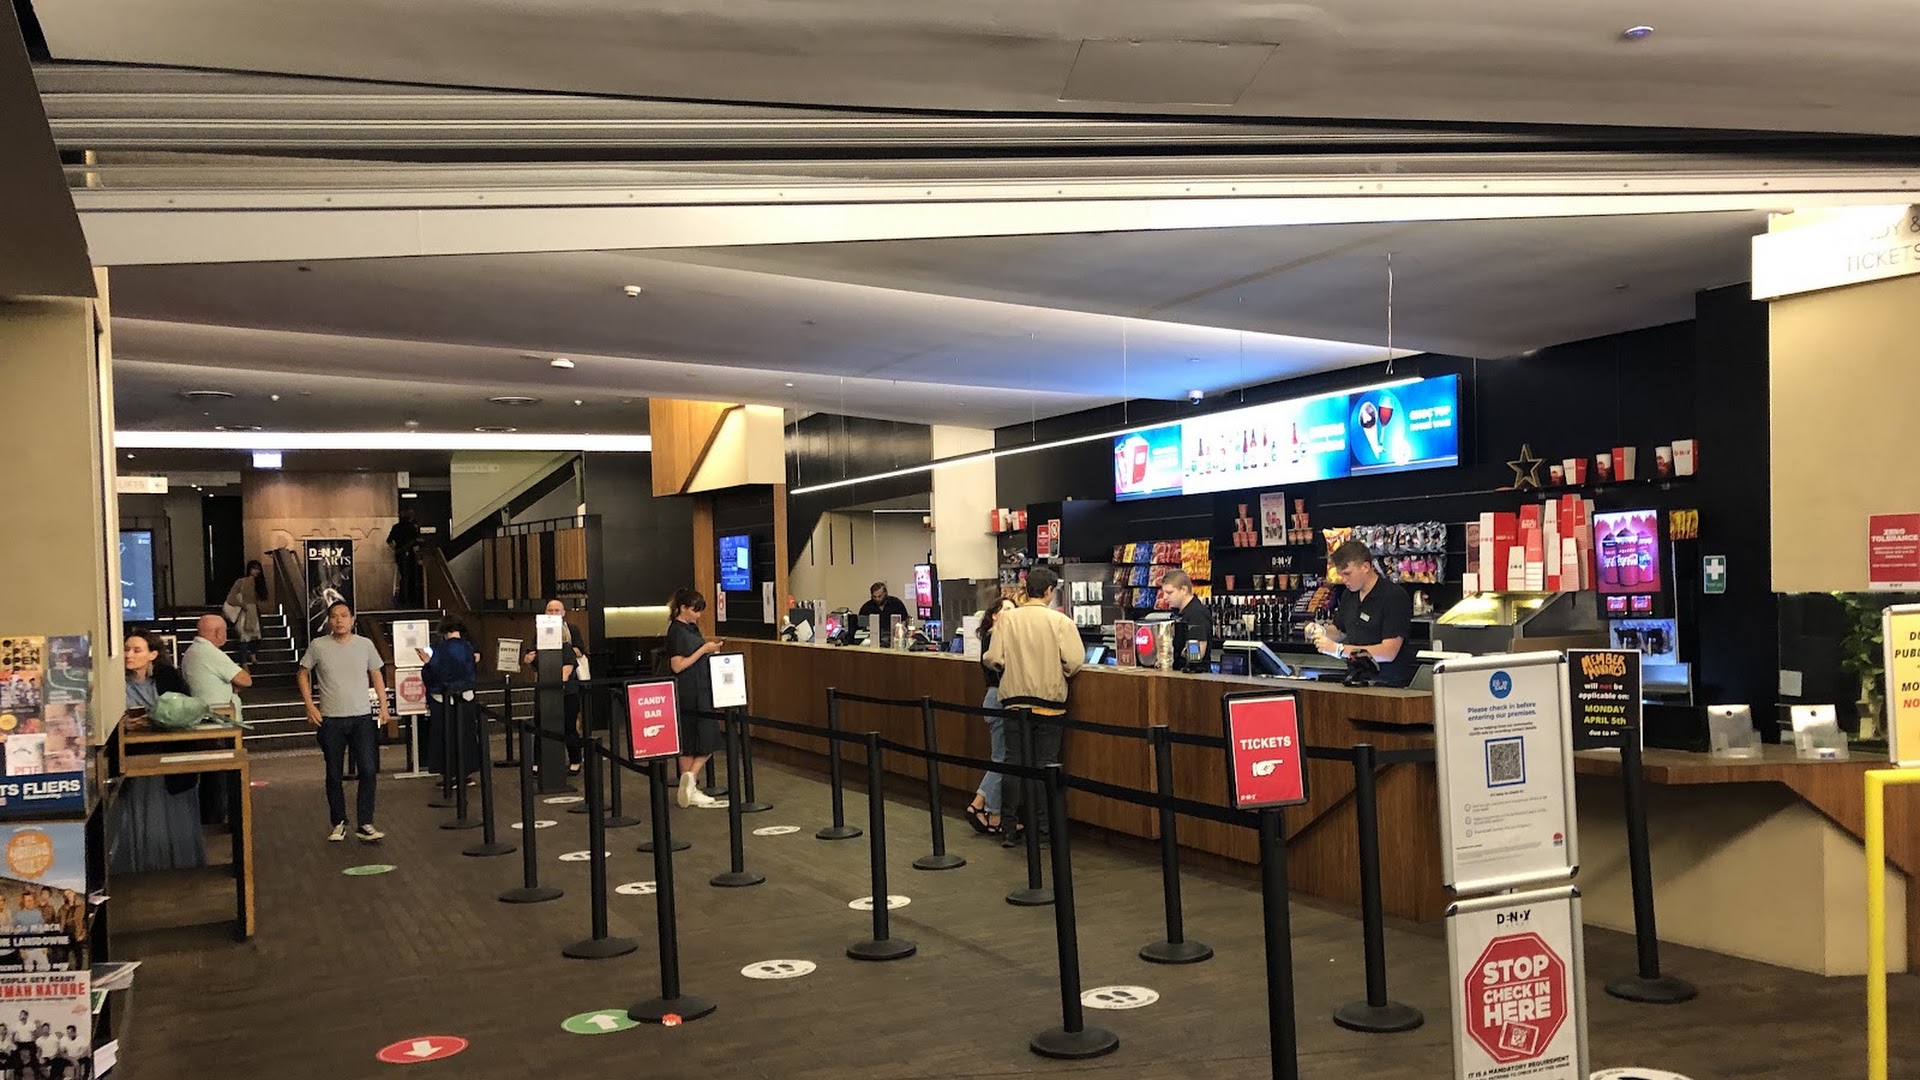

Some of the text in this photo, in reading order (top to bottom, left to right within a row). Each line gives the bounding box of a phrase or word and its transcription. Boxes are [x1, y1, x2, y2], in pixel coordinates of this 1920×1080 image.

[1871, 534, 1918, 542] TOLERANCE
[323, 556, 351, 566] ARTS
[1581, 653, 1626, 674] MEMBER
[1584, 682, 1598, 690] will
[1613, 682, 1623, 690] be
[637, 696, 666, 706] CANDY
[1578, 691, 1616, 701] applicable
[644, 709, 662, 719] BAR
[1585, 704, 1625, 713] MONDAY
[1468, 713, 1494, 721] entering
[1507, 710, 1537, 718] premises.
[1584, 715, 1626, 725] APRIL 5th
[1239, 736, 1291, 751] TICKETS
[23, 779, 81, 796] FLIERS
[13, 935, 70, 947] LANSDOWNE
[1483, 954, 1549, 985] STOP
[36, 982, 86, 996] NATURE
[1483, 981, 1551, 1004] CHECK IN
[1483, 996, 1551, 1028] HERE
[1488, 1064, 1527, 1075] MANDATORY
[1528, 1055, 1570, 1069] REQUIREMENT
